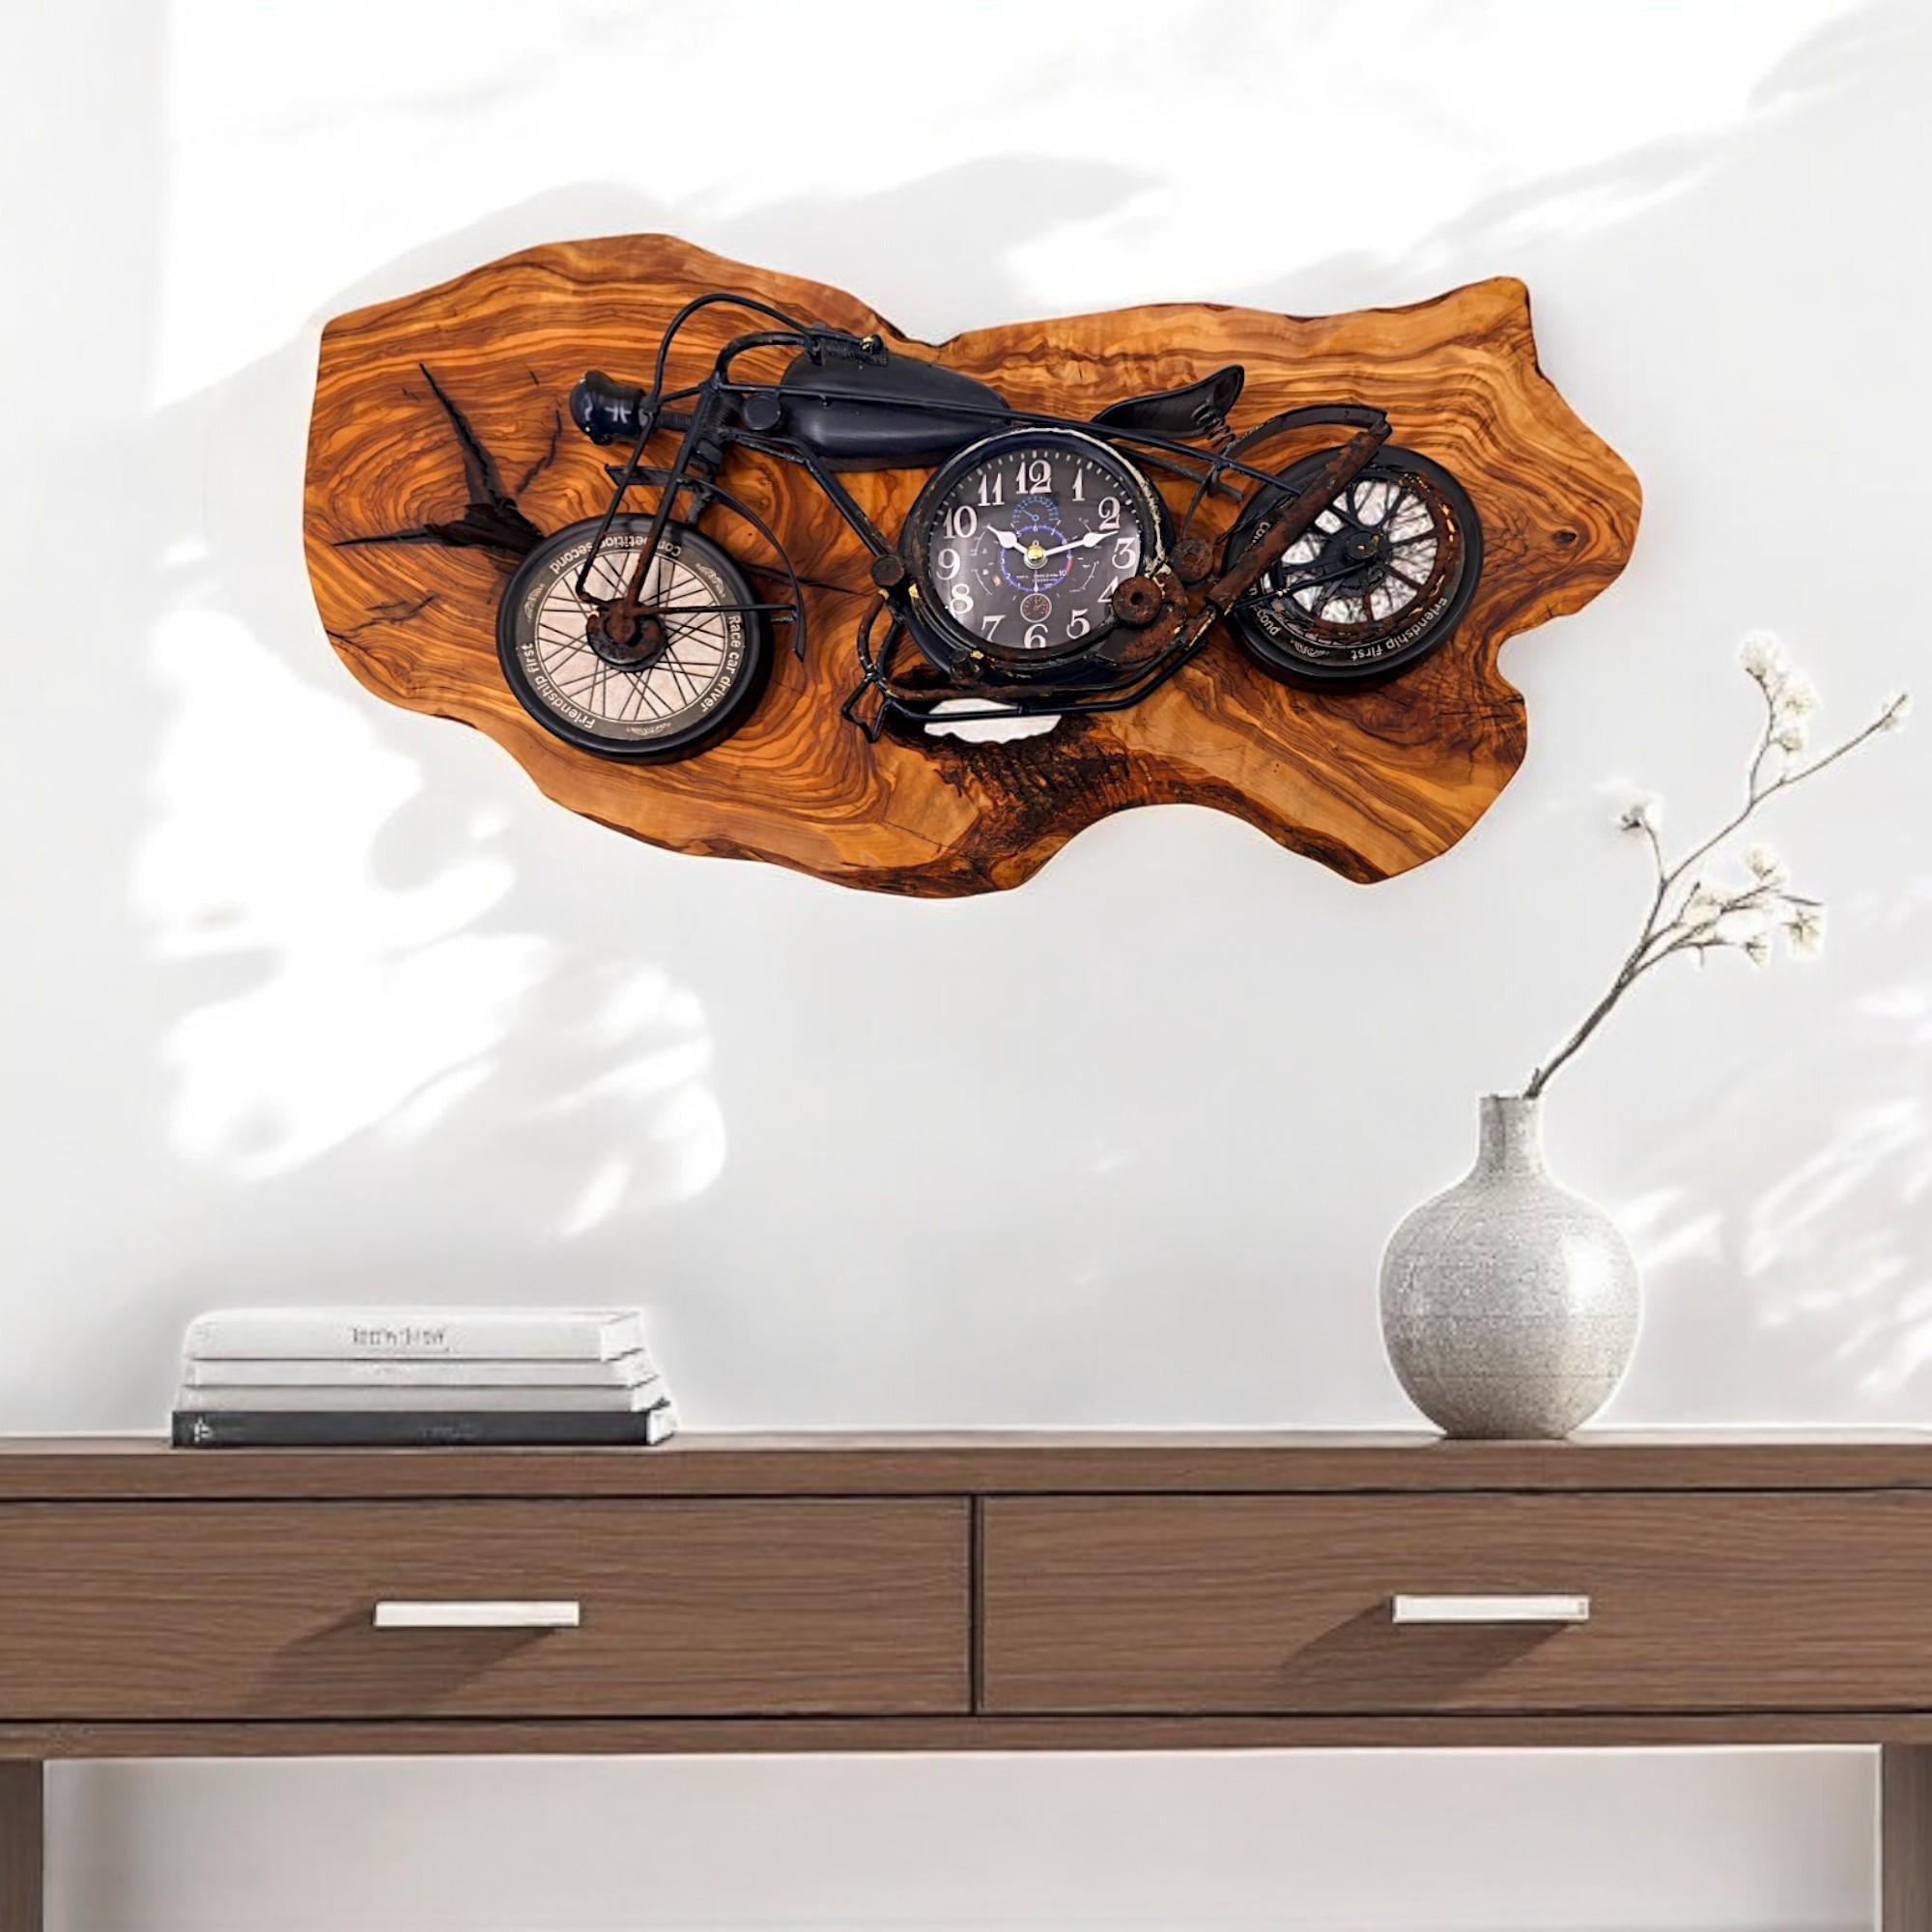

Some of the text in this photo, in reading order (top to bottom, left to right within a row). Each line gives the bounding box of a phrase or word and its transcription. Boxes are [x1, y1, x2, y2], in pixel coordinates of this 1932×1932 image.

[978, 473, 1005, 506] 11
[1016, 460, 1052, 494] 12
[1072, 469, 1085, 501] 1
[943, 506, 978, 539] 10
[1098, 497, 1121, 530] 2
[600, 535, 681, 556] Cometition
[1112, 537, 1136, 569] 3
[936, 548, 960, 580] 9
[950, 584, 974, 614] 8
[1097, 577, 1118, 603] 4
[981, 614, 1006, 642] 7
[1024, 623, 1049, 648] 6
[1066, 609, 1090, 639] 5
[1386, 597, 1448, 649] Friendship
[521, 642, 540, 674] first
[699, 615, 742, 713] Race car driver
[1350, 647, 1383, 661] first
[535, 675, 596, 729] Friendship
